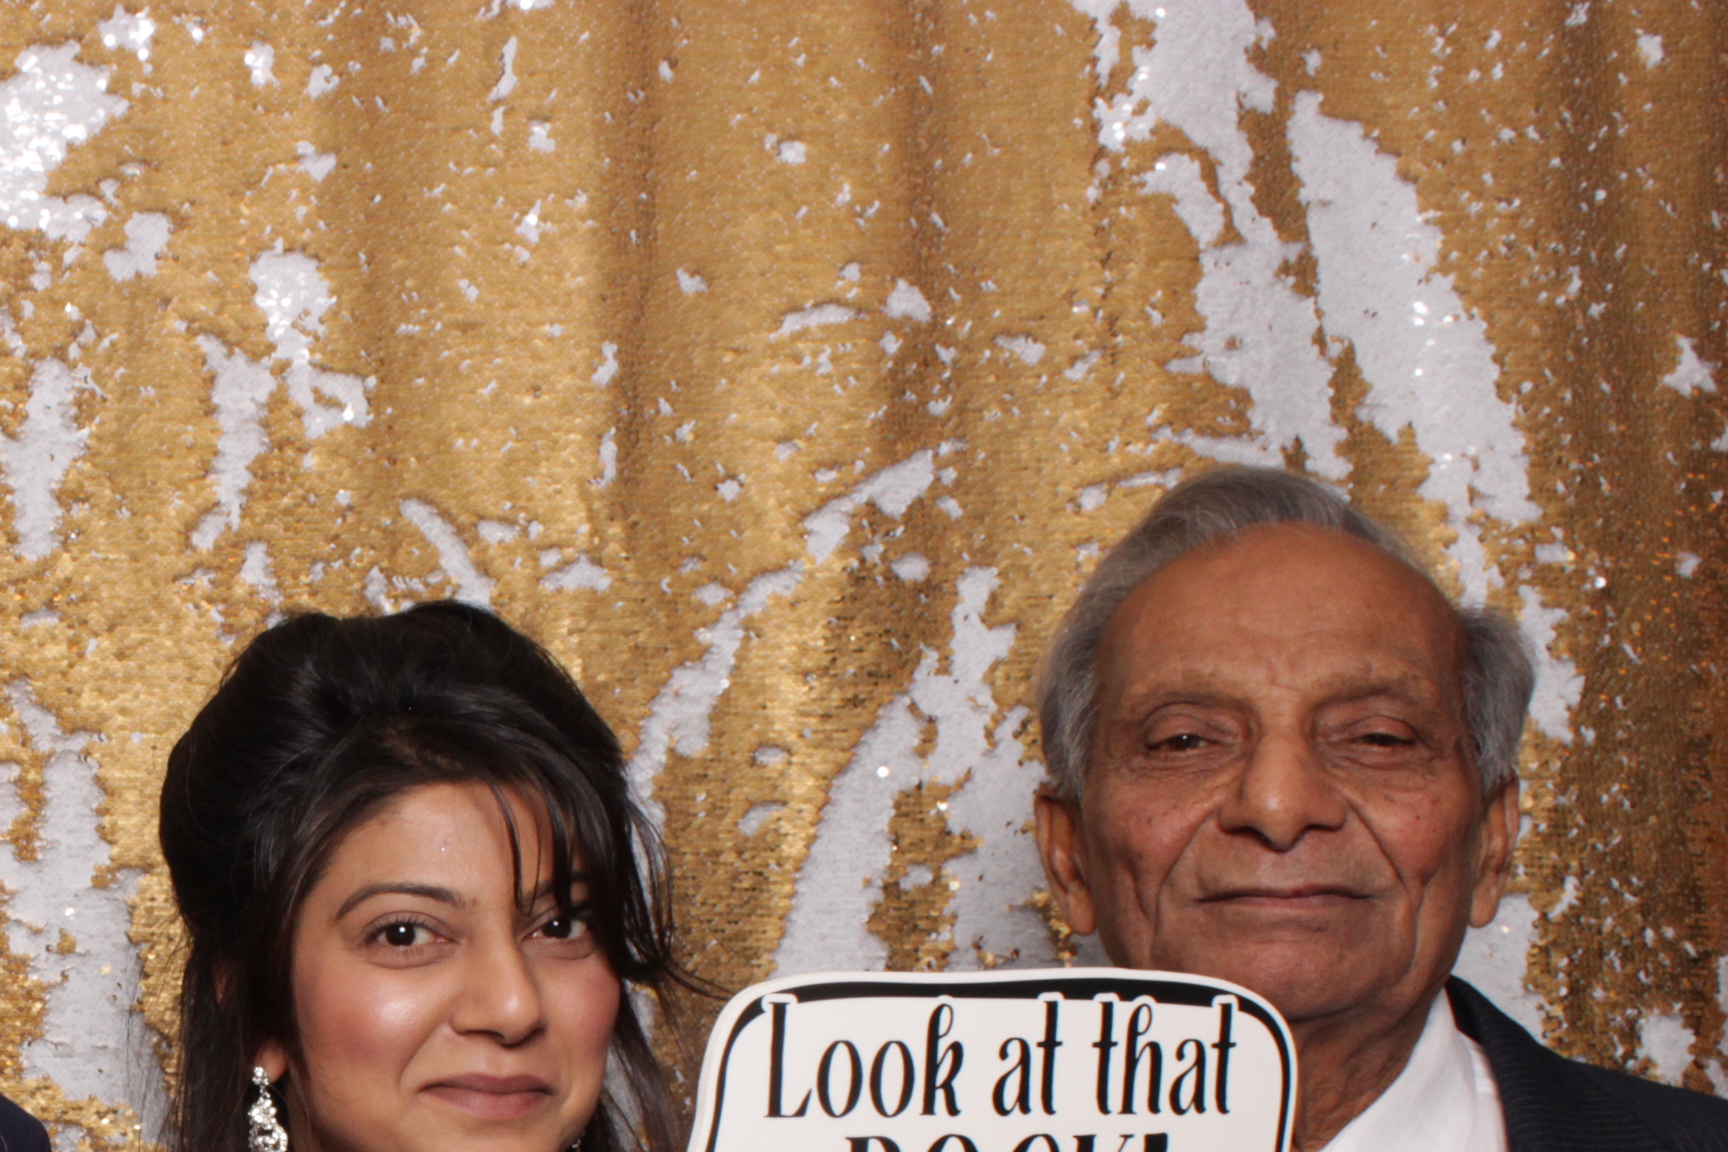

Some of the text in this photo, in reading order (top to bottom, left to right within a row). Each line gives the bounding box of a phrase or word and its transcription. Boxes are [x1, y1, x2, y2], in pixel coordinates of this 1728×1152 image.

[764, 999, 1238, 1119] Look at that
